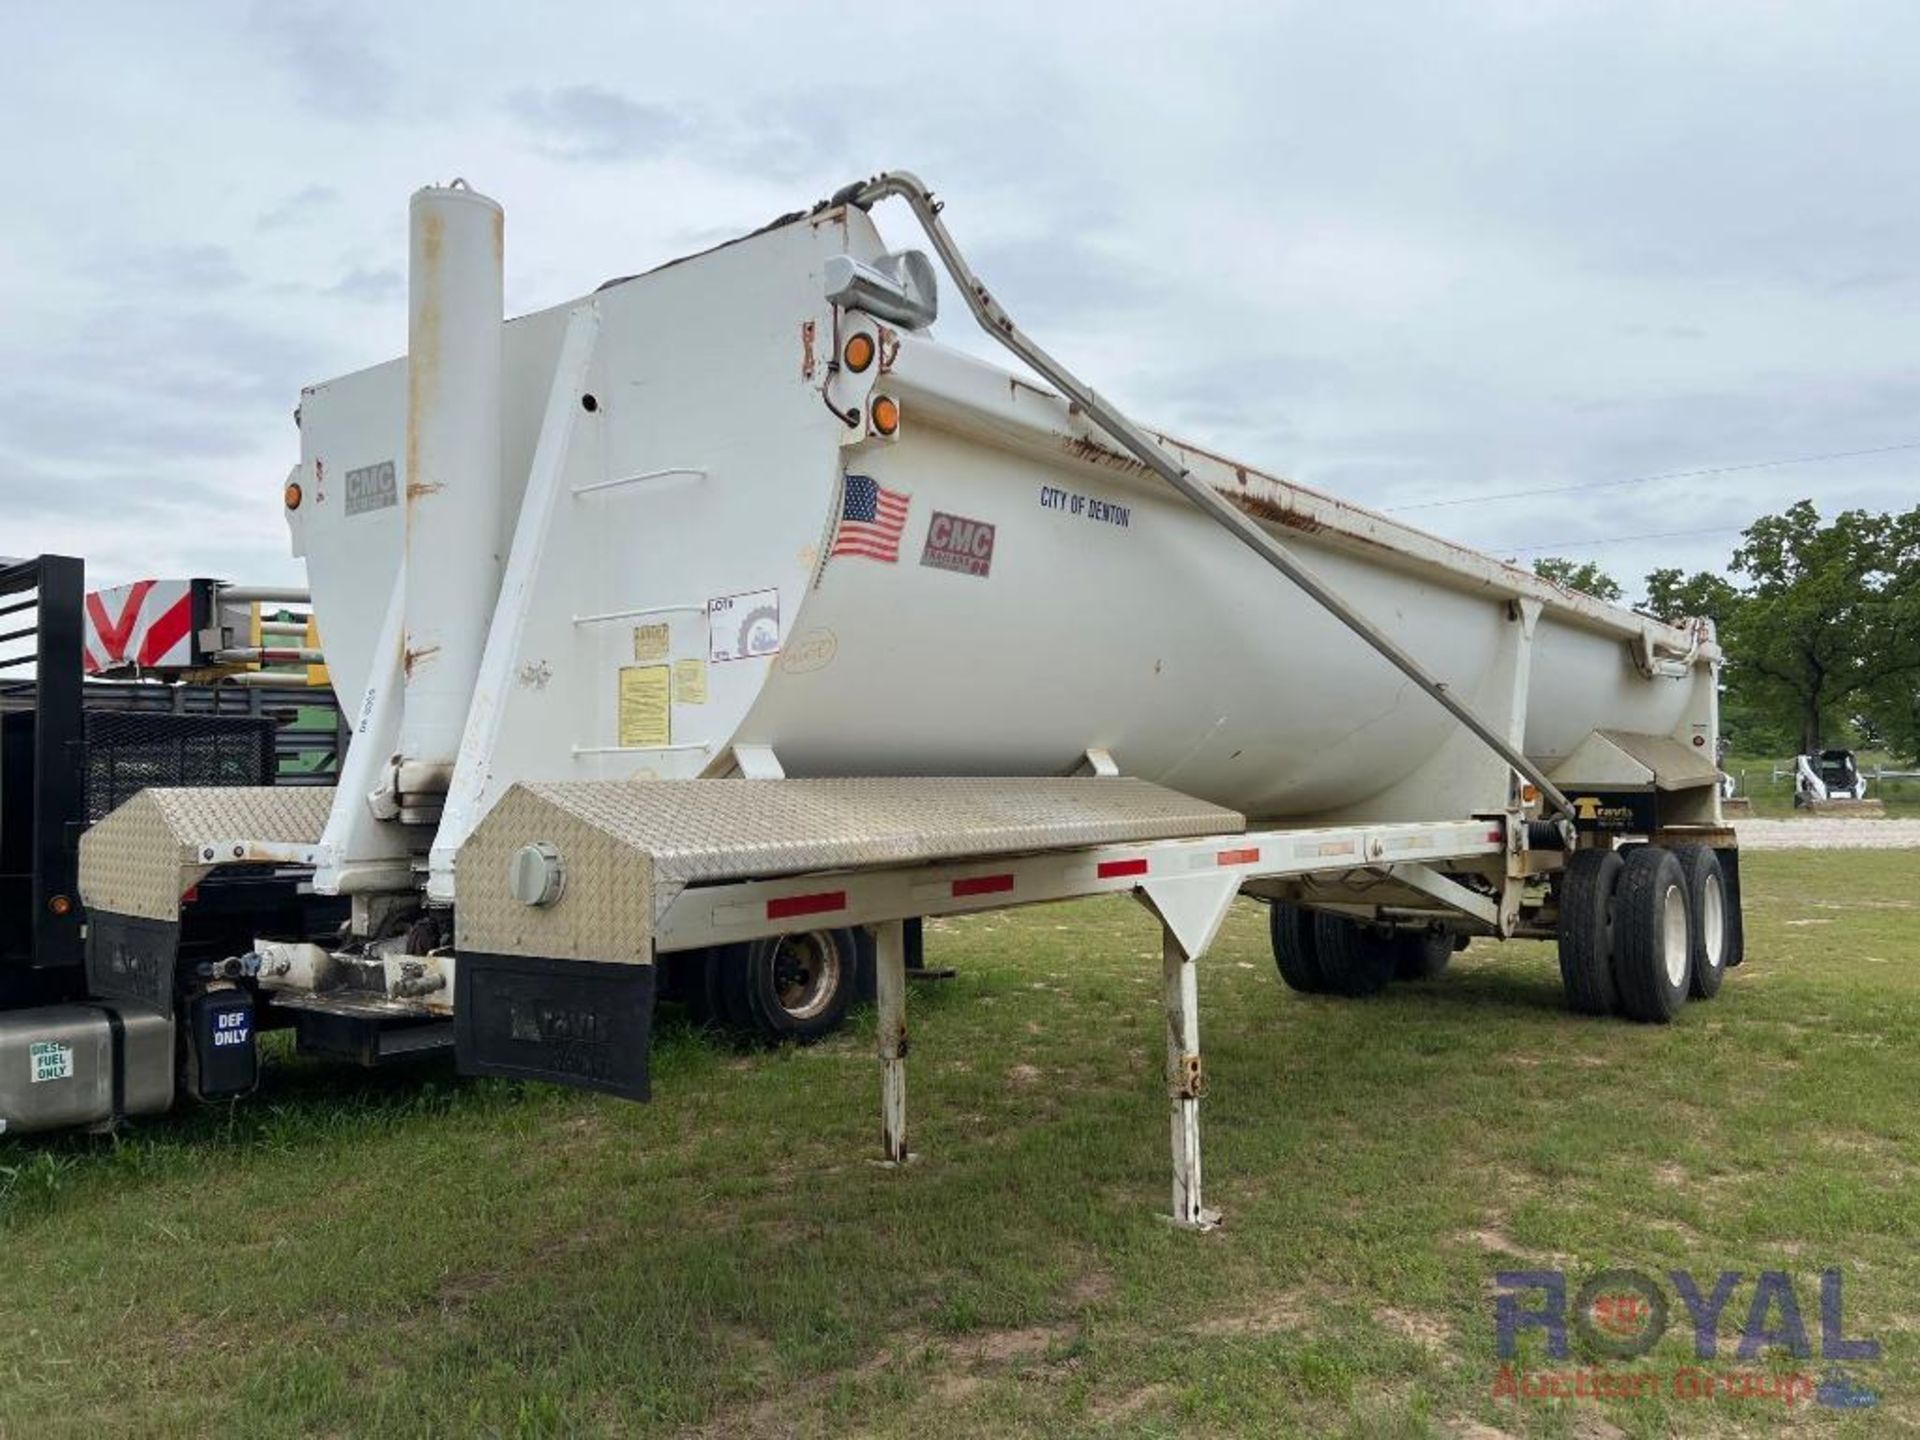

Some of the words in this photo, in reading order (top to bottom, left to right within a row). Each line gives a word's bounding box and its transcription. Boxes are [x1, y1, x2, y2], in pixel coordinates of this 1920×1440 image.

[347, 464, 394, 498] CMC
[1041, 486, 1066, 510] CITY
[1071, 494, 1085, 515] OF
[1088, 499, 1131, 528] DENTON
[930, 516, 993, 557] CMC
[219, 1013, 244, 1028] DEF
[215, 1029, 248, 1045] ONLY
[37, 1054, 66, 1067] FUEL
[37, 1066, 66, 1079] ONLY
